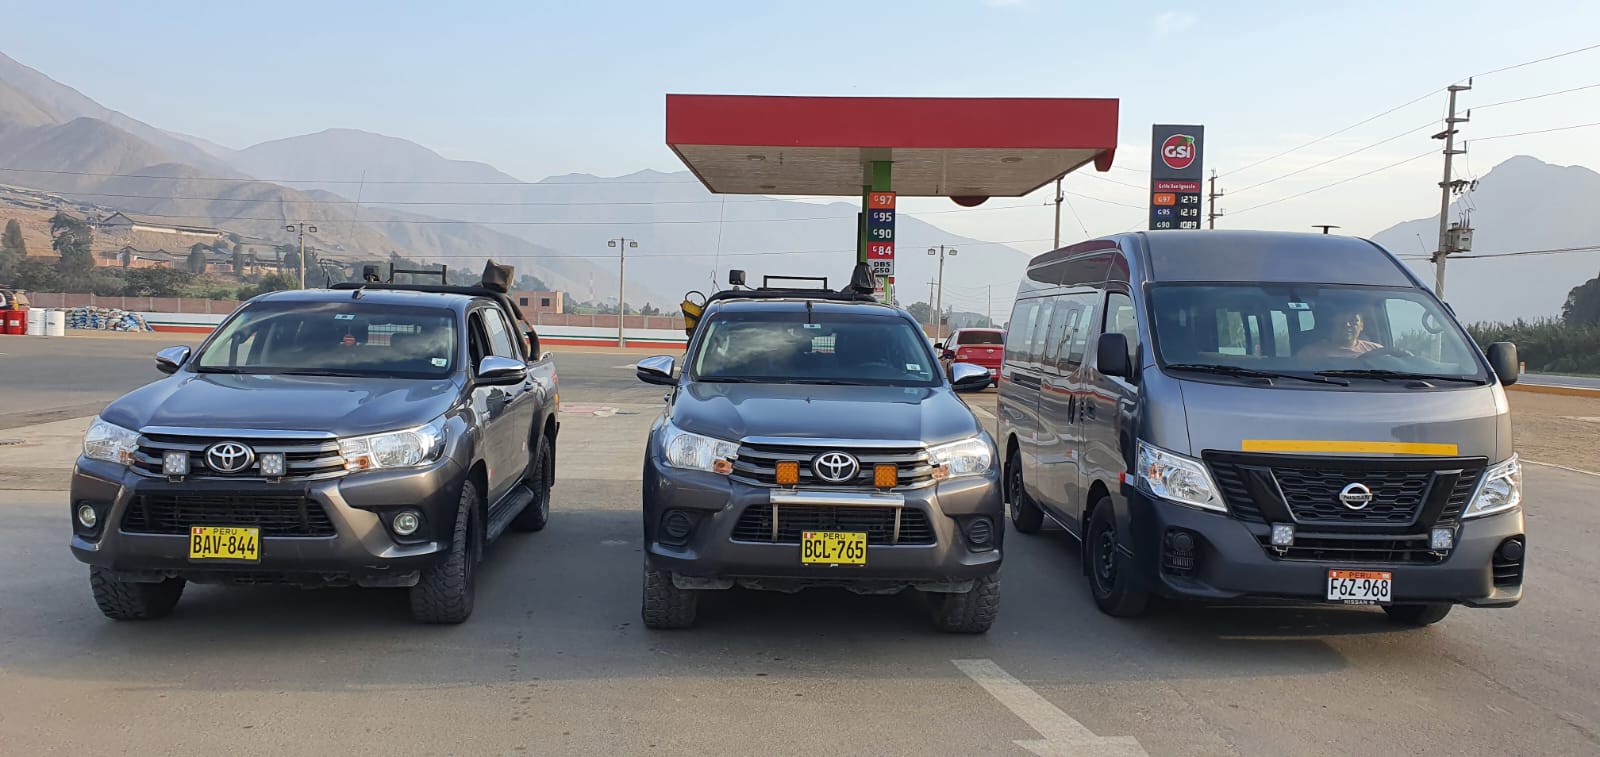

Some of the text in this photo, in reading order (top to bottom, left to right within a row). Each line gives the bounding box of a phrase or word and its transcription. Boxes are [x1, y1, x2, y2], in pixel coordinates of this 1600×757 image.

[193, 534, 255, 555] BAV-844
[823, 532, 846, 540] PERU
[804, 539, 864, 559] BCL-765
[1330, 578, 1389, 597] F6Z-968
